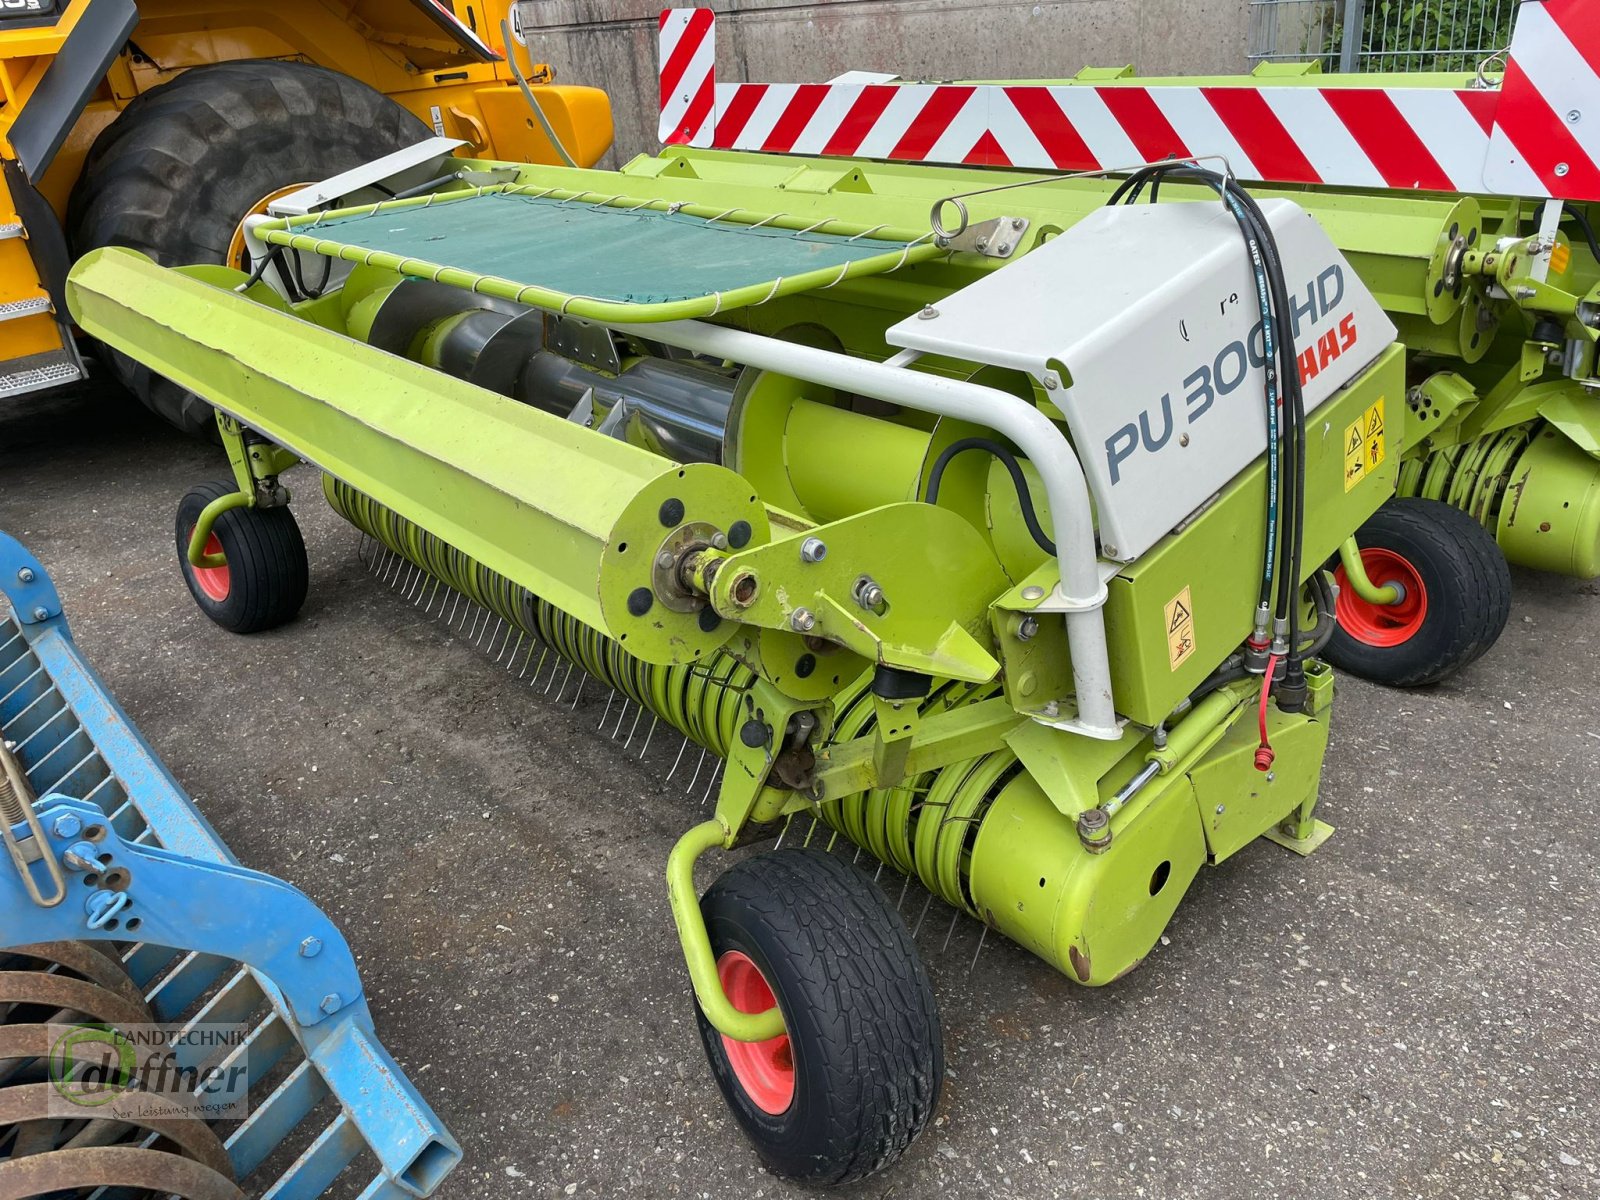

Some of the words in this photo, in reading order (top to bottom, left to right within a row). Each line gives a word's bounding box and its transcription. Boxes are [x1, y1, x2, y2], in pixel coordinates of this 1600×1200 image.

[1105, 392, 1174, 487] PU
[1183, 315, 1279, 424] 300
[1289, 264, 1344, 340] HD
